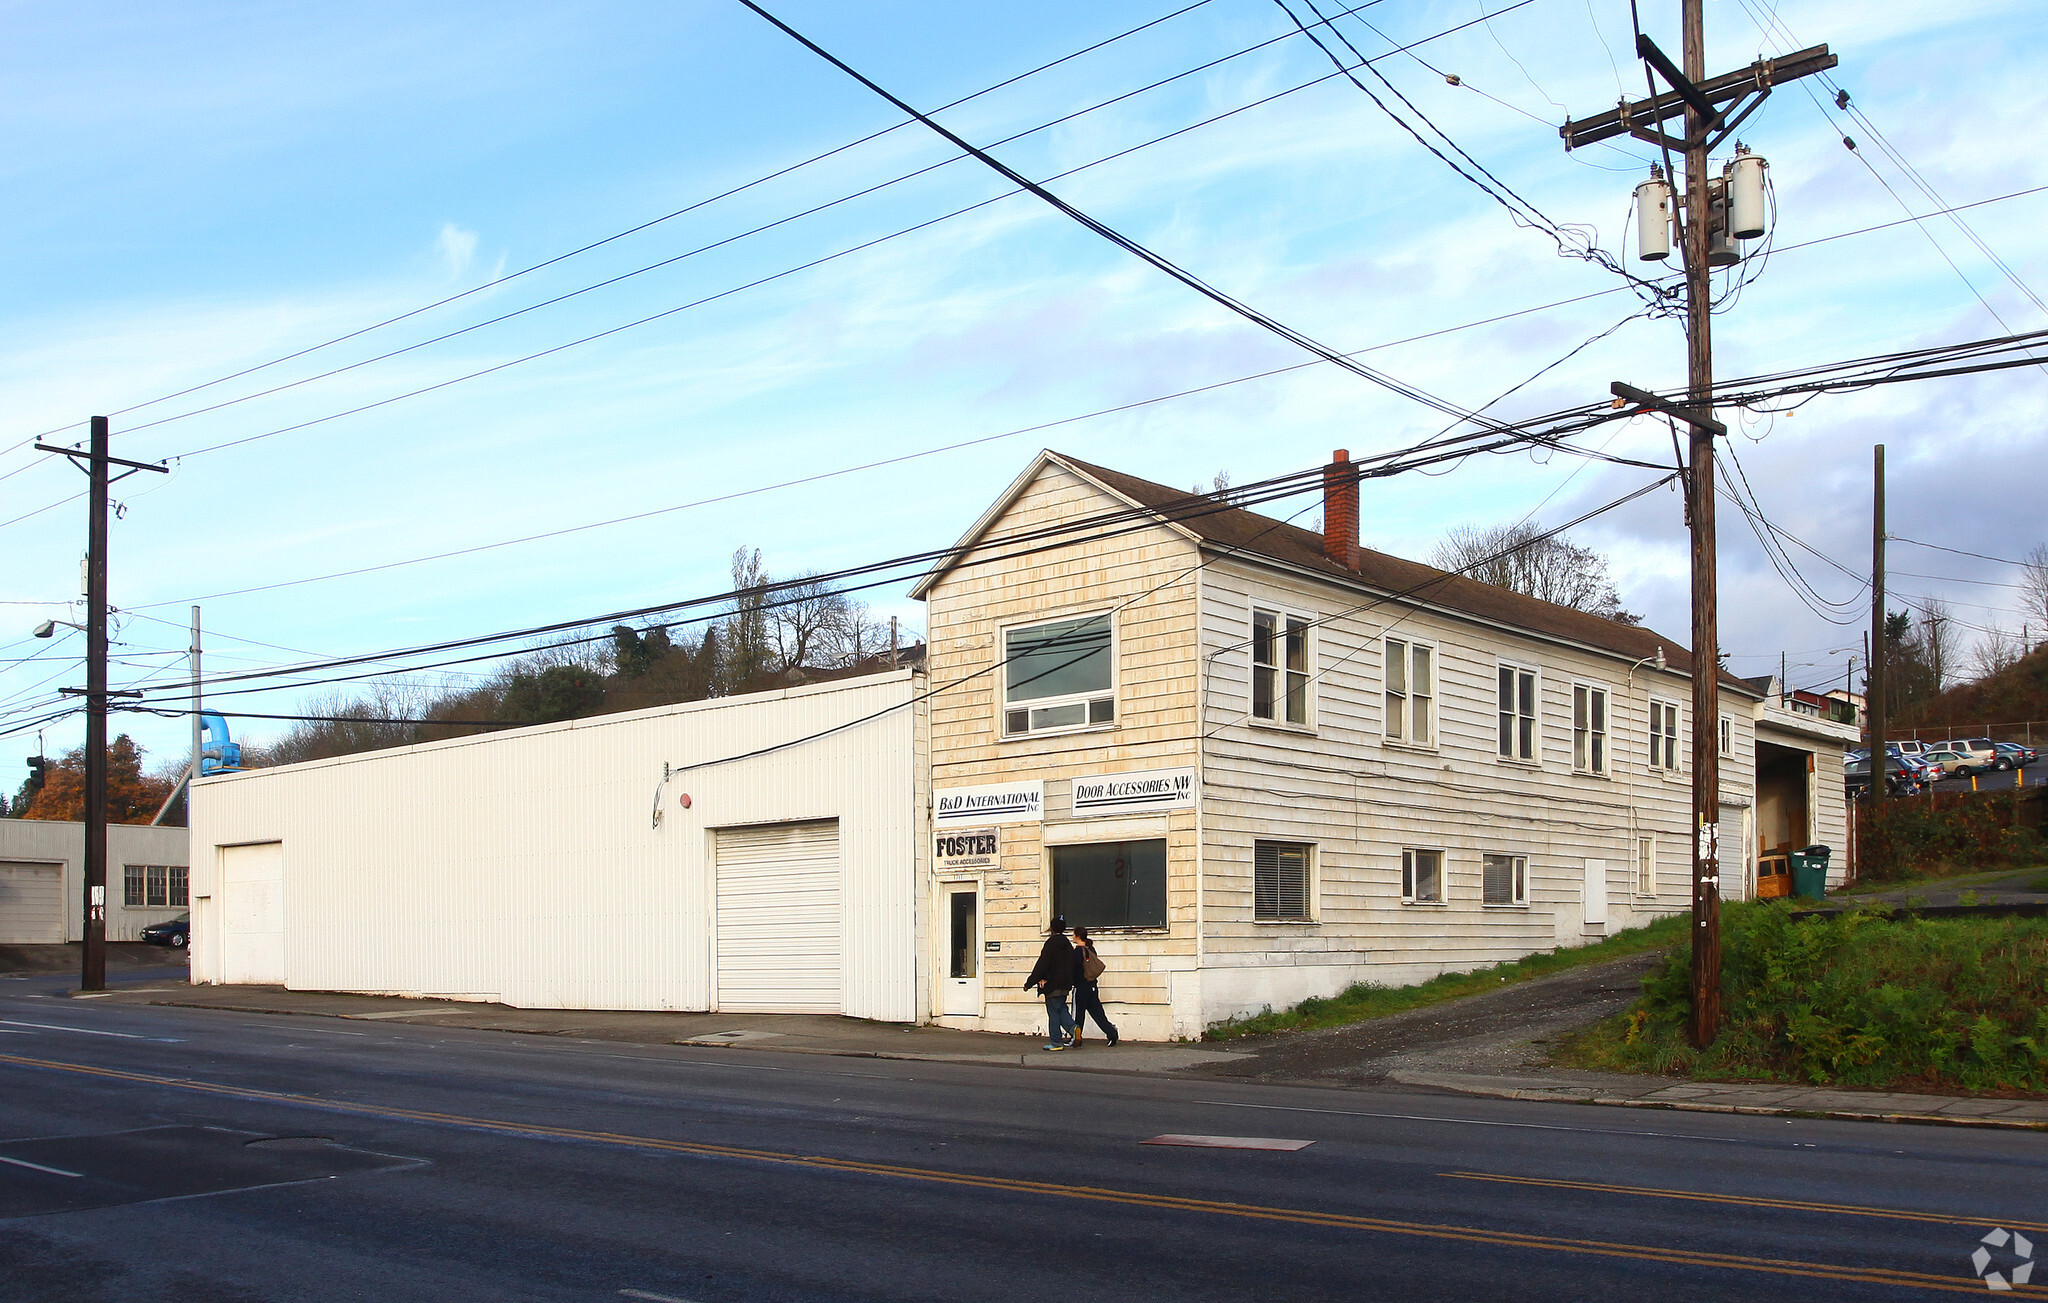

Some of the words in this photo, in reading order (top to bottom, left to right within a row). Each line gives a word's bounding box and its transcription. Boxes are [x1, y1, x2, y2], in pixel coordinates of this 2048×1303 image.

[1076, 785, 1104, 799] DOOR
[1105, 778, 1171, 797] ACCESSORIES
[1172, 775, 1192, 791] NW
[939, 796, 963, 811] B&D
[965, 791, 1040, 808] INTERNATIONAL
[1177, 790, 1191, 800] INC
[1027, 803, 1040, 812] INC
[936, 834, 997, 857] FOSTER
[959, 857, 991, 865] ACCESSORIES
